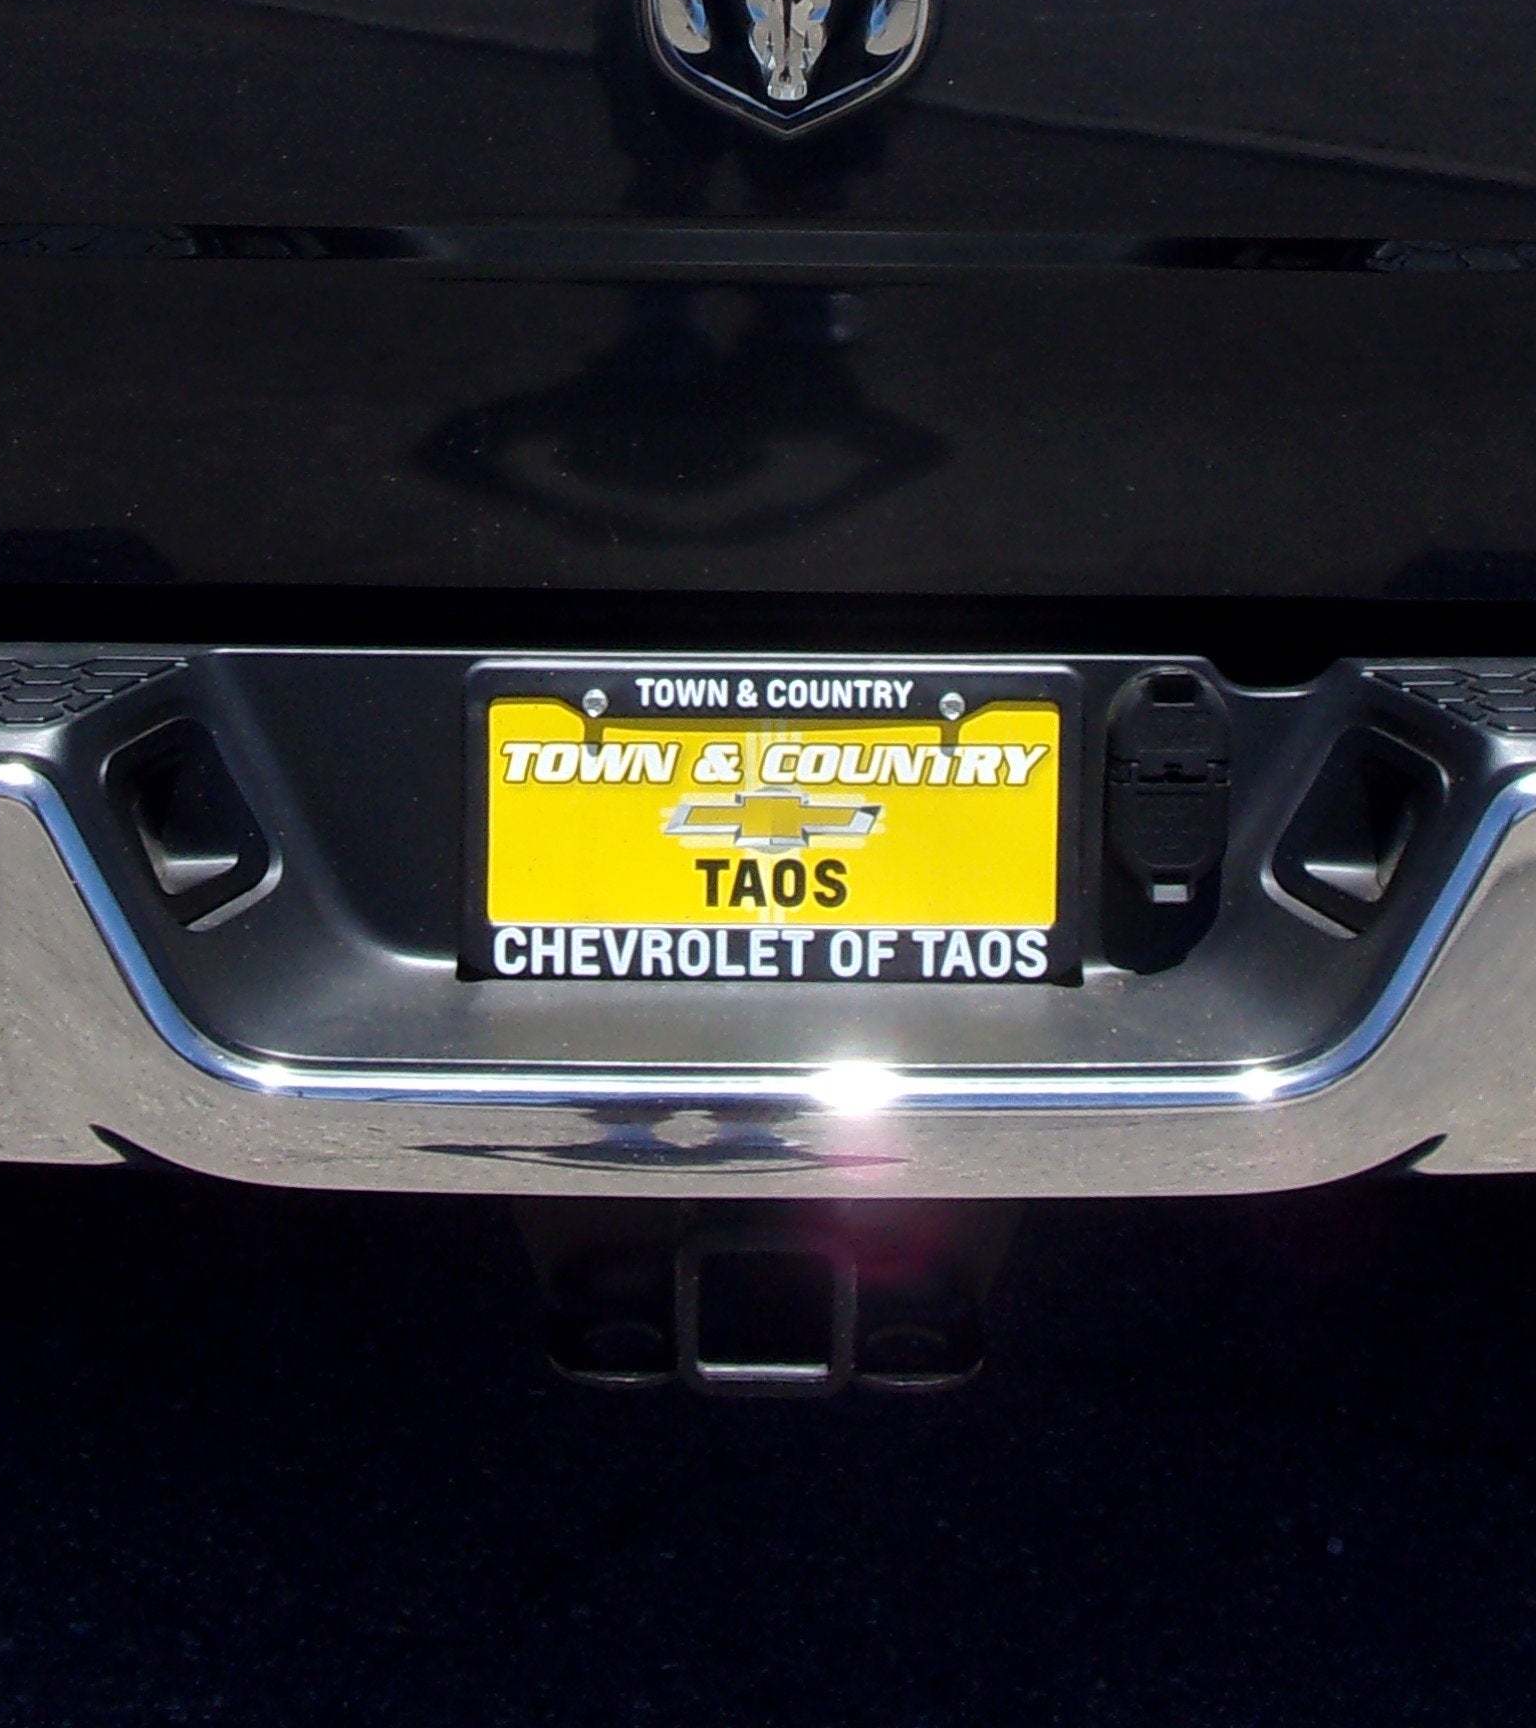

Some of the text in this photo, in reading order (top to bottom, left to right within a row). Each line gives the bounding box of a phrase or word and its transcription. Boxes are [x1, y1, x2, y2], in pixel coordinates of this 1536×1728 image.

[635, 677, 914, 710] TOWN & COUNTRY
[501, 741, 1051, 787] TOWN & COUNTRY
[695, 858, 848, 909] TAOS
[492, 927, 1049, 980] CHEVROLET OF TAOS
